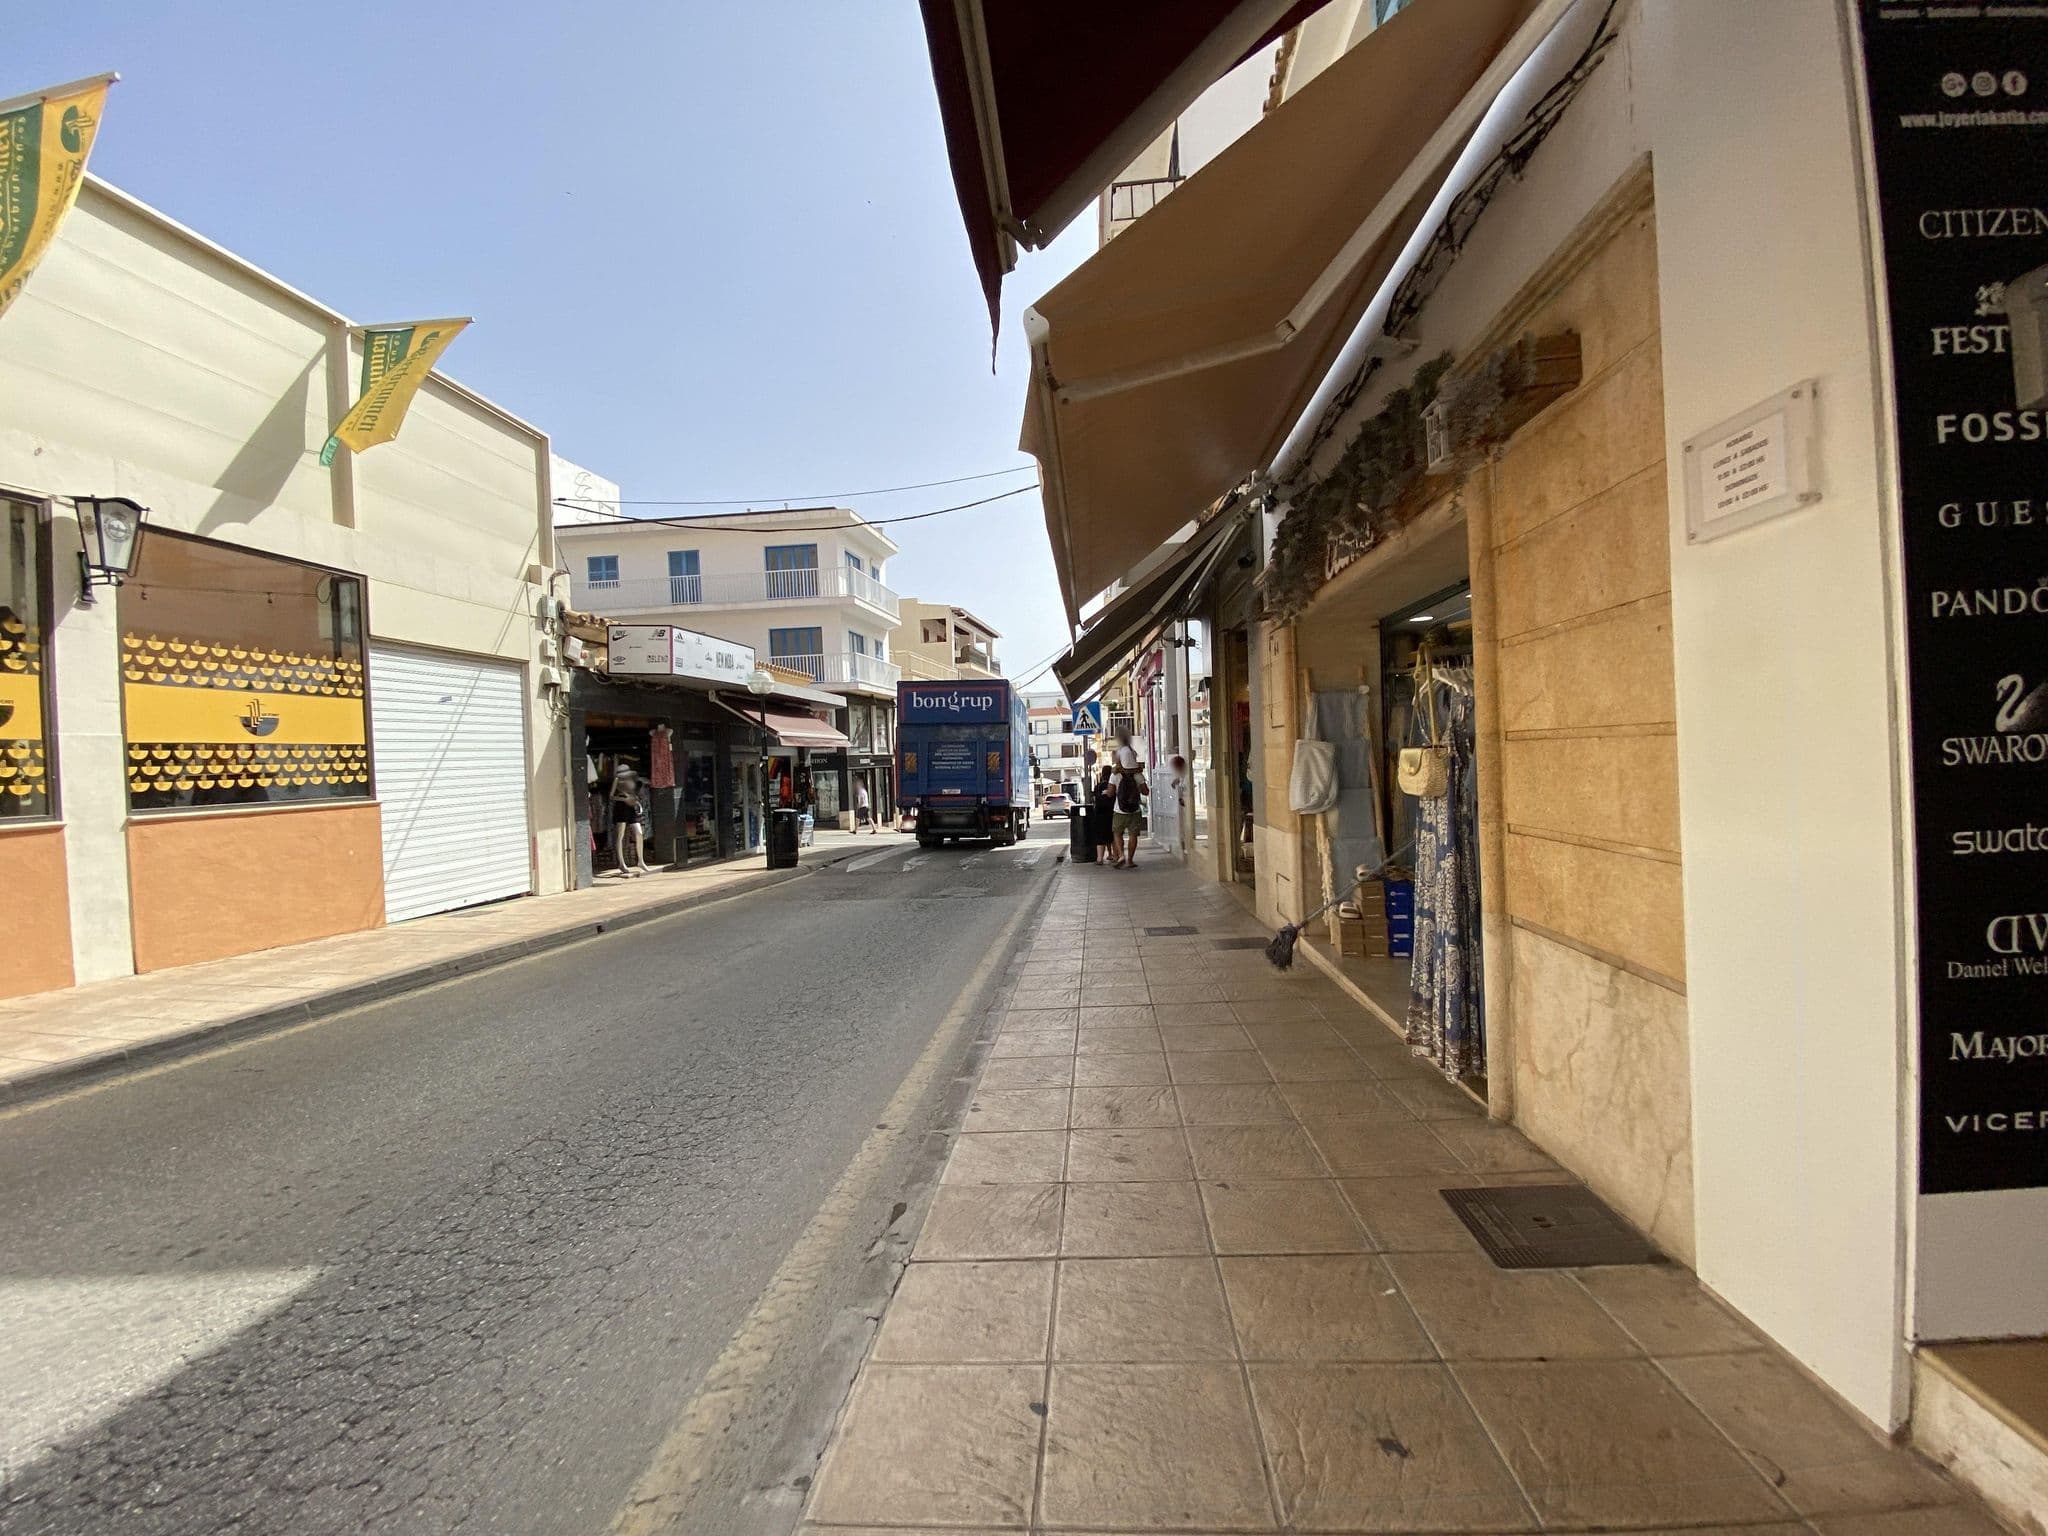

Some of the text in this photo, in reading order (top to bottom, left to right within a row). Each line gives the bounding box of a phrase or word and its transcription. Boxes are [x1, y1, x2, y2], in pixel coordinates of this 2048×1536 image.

[1919, 207, 2048, 239] CITIZEN
[1930, 325, 2009, 356] FEST
[1938, 499, 2048, 528] GUE
[912, 691, 993, 713] bongrup
[1947, 958, 2009, 980] Daniel
